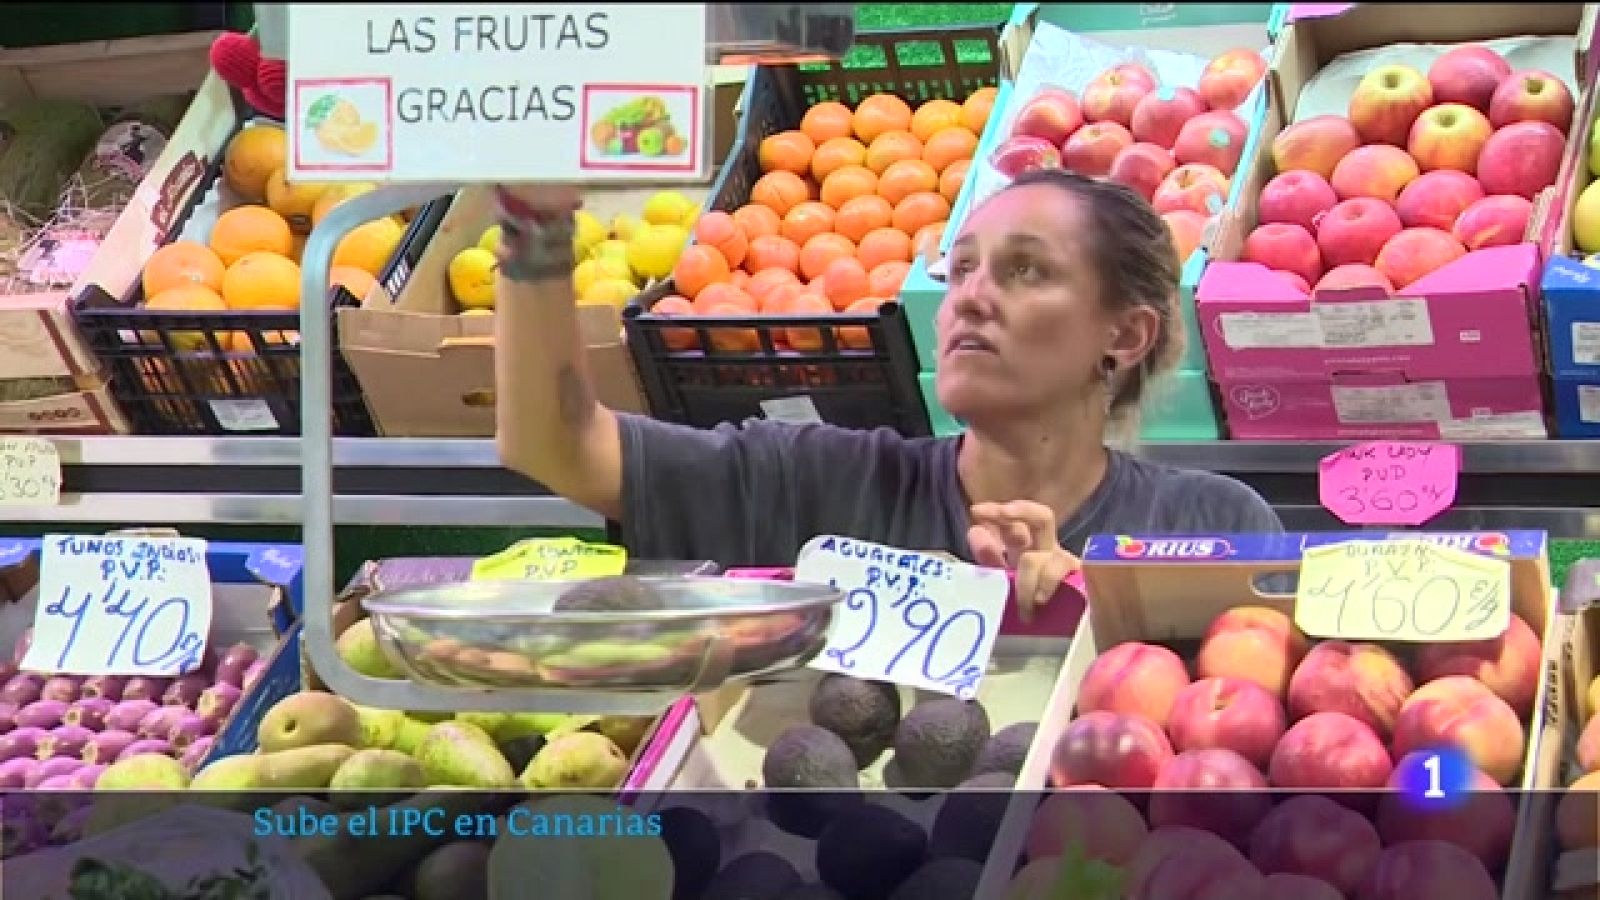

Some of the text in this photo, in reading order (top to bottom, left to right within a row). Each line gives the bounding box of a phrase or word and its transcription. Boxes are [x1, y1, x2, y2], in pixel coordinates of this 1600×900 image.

[366, 12, 610, 54] LAS FRUTAS
[56, 535, 123, 557] TUNOS
